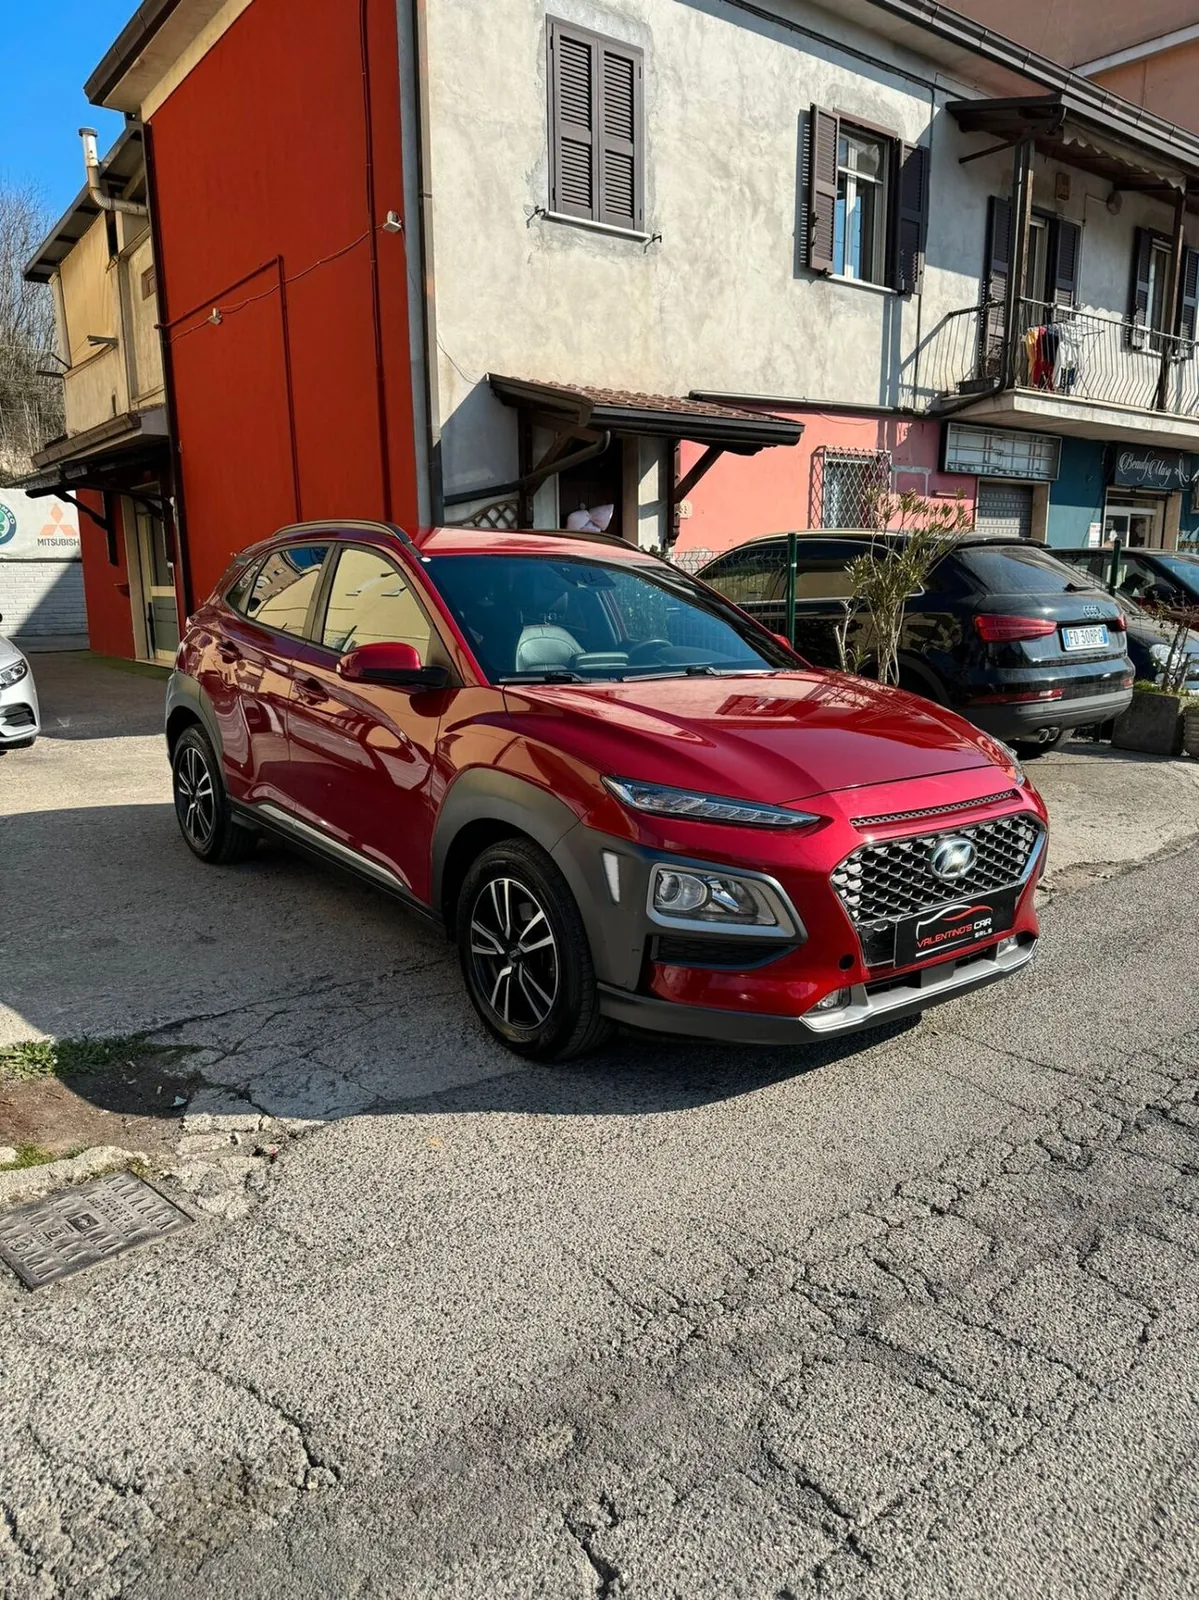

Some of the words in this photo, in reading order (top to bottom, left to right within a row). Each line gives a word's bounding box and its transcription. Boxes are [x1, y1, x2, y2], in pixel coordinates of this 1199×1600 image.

[0, 504, 16, 525] MEO
[37, 538, 80, 547] MITSUBISH
[916, 923, 973, 948] VALENTINO'S
[973, 917, 992, 930] CAR
